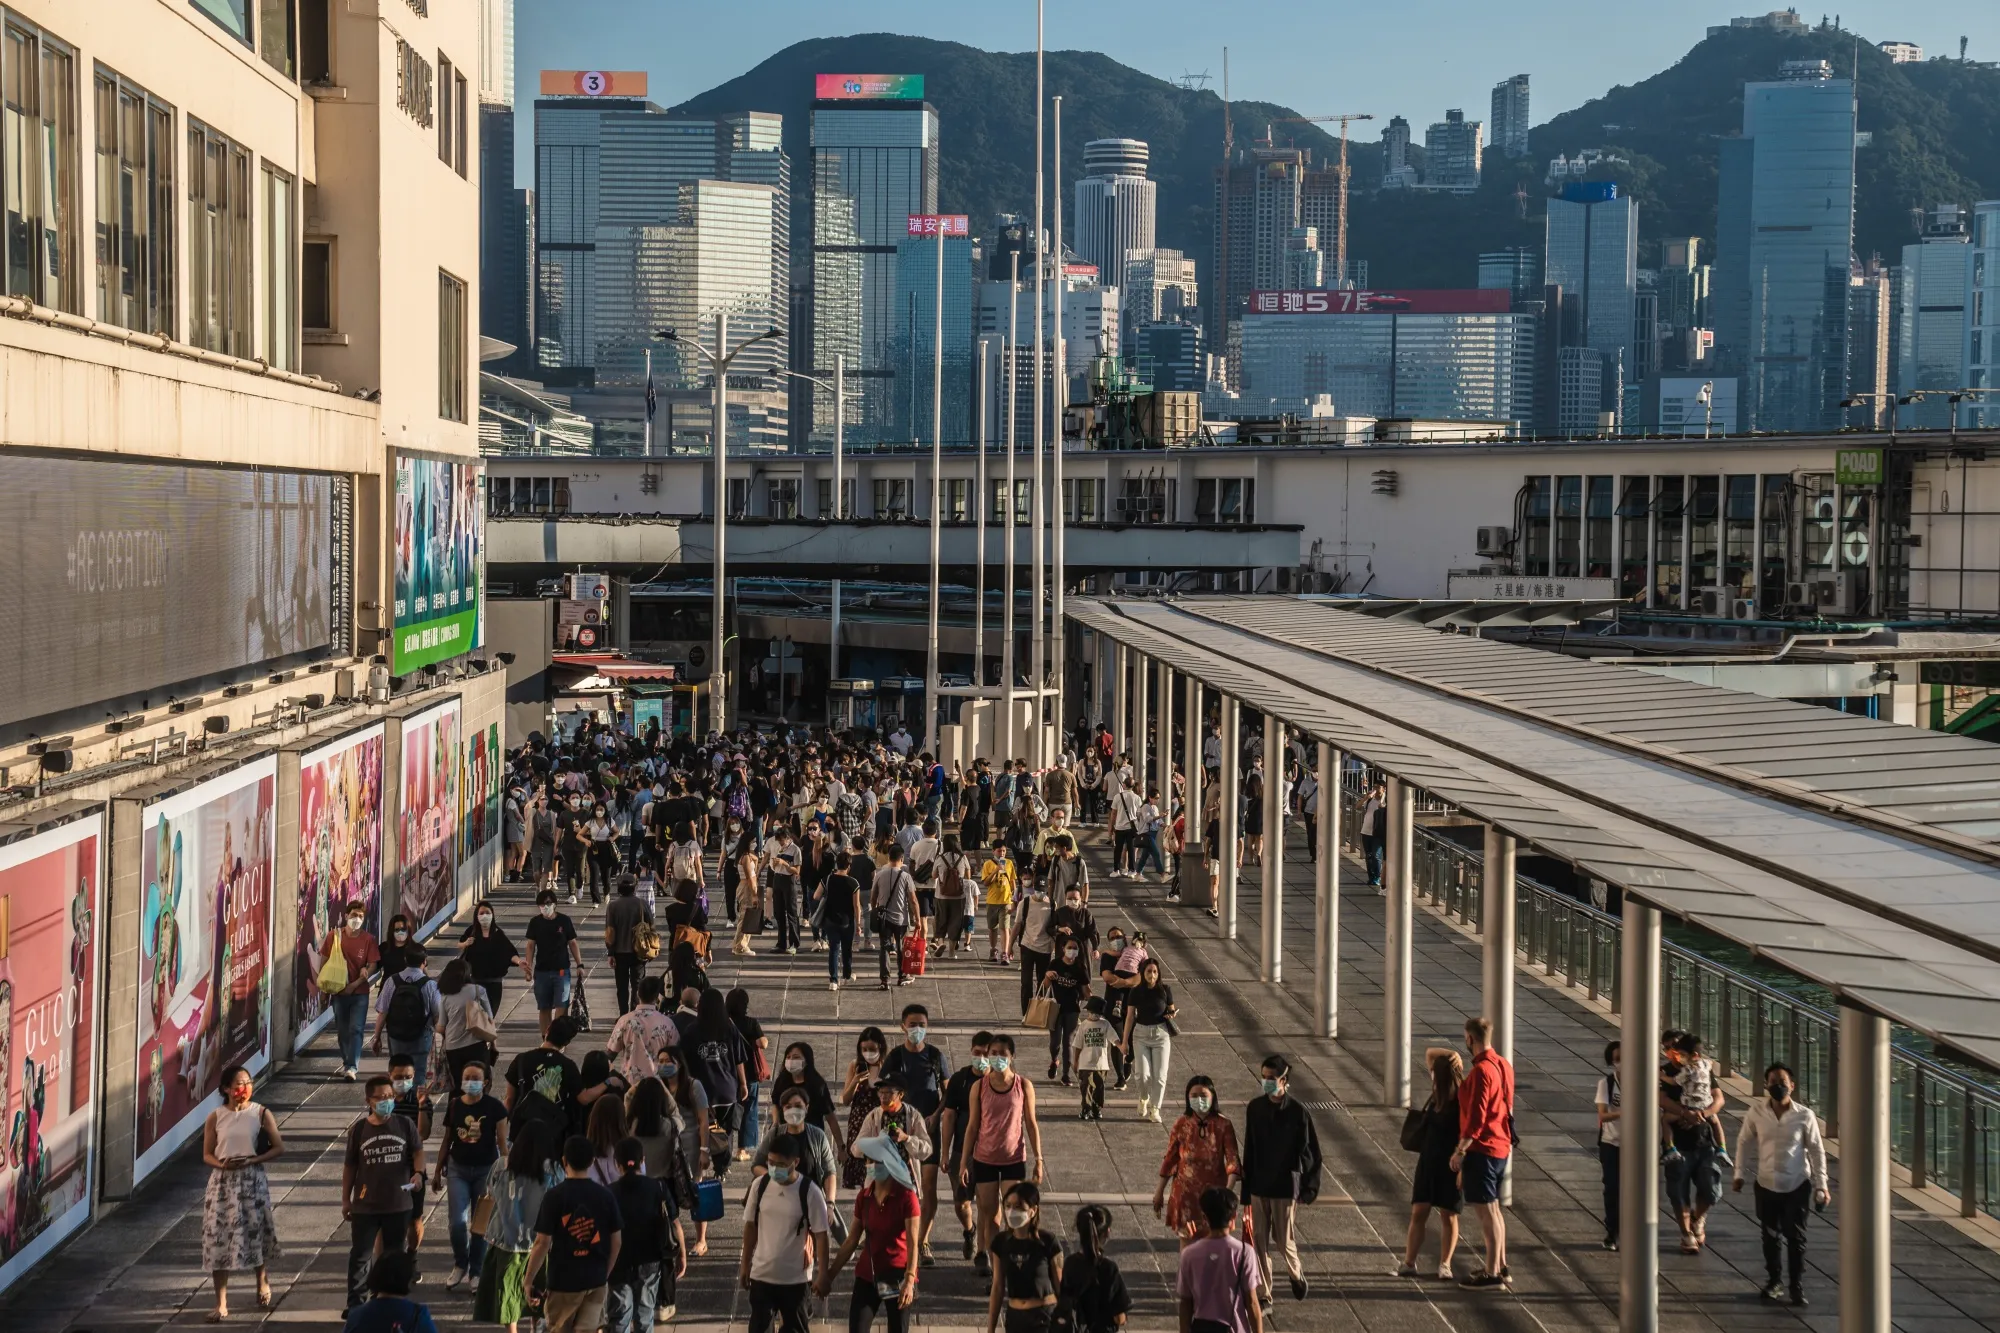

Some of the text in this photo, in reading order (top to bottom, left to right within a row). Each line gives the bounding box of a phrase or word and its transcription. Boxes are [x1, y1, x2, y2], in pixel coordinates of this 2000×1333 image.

[588, 76, 600, 91] 3
[908, 217, 967, 233] 瑞安集團
[1258, 292, 1329, 312] 恒驰5
[1840, 452, 1878, 473] POAD
[223, 864, 264, 925] GUCCI
[230, 920, 254, 957] FLORA
[25, 981, 84, 1055] GUCCI
[36, 1047, 71, 1085] FLORA
[363, 1144, 403, 1156] ATHLETICS
